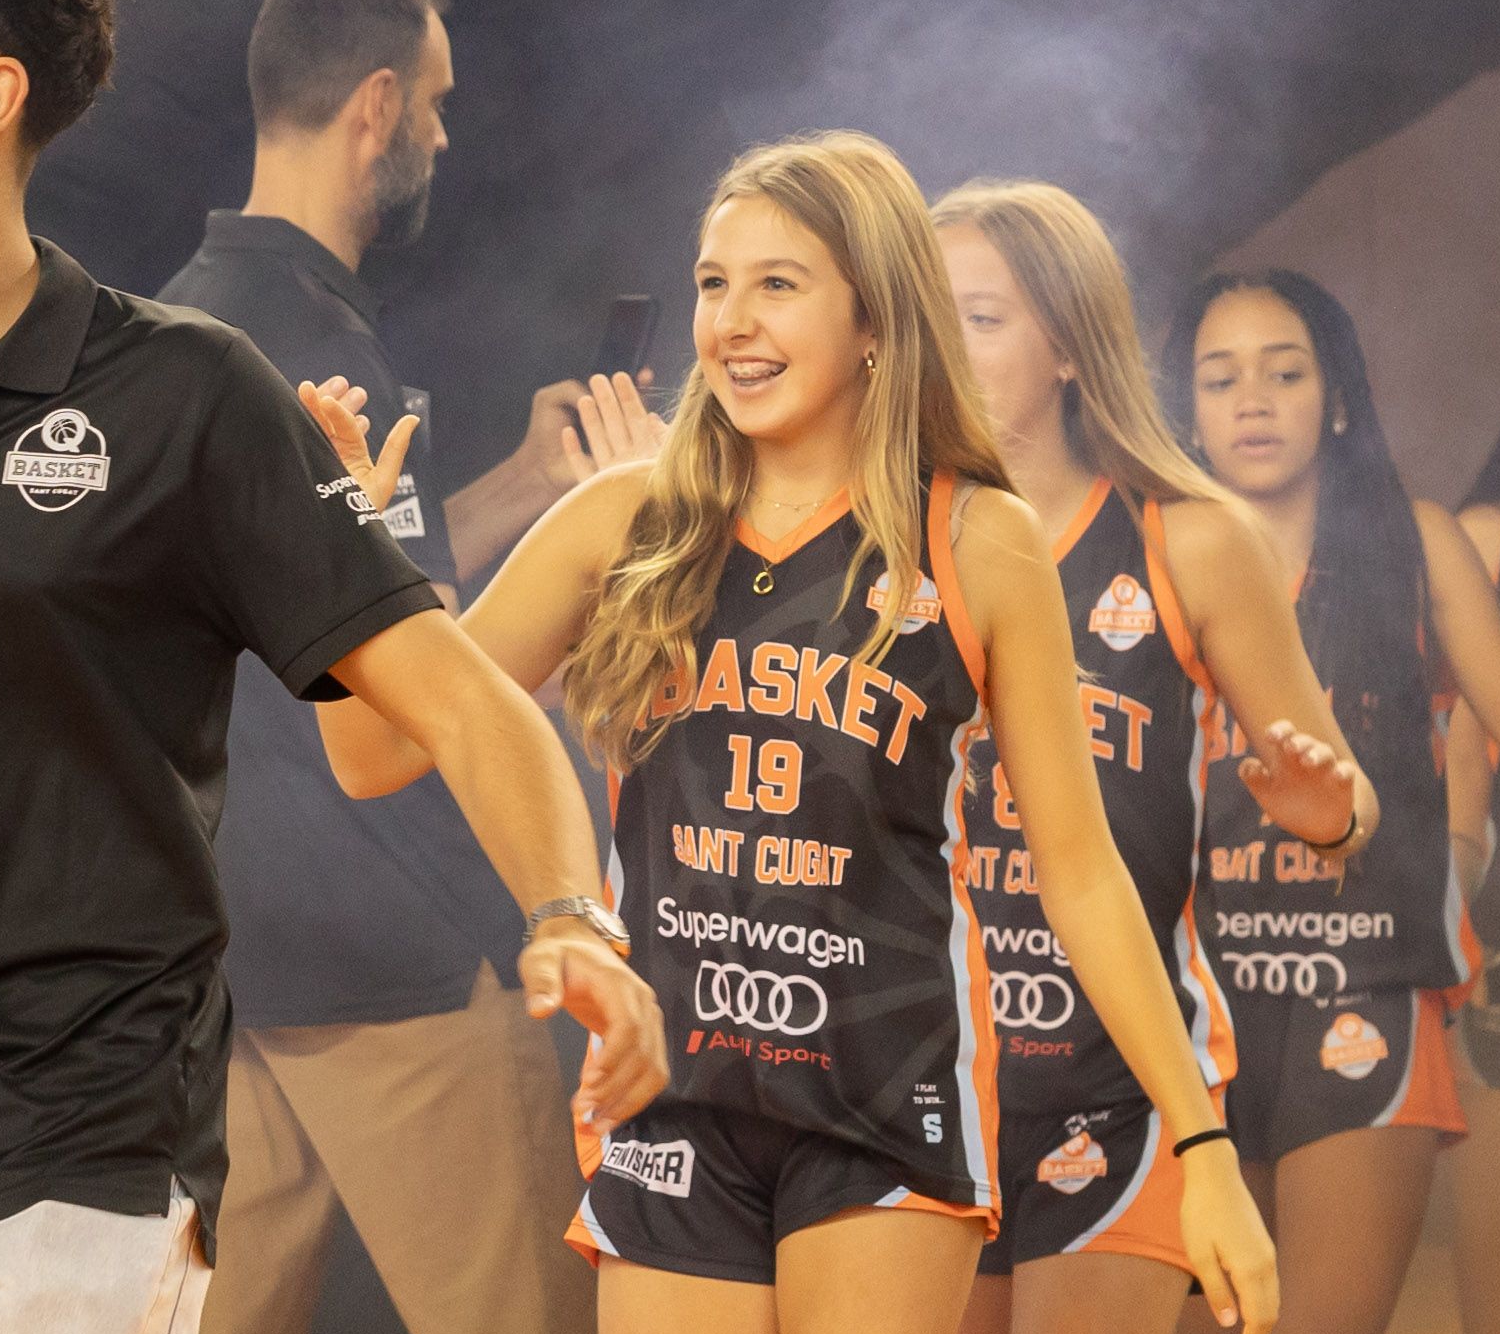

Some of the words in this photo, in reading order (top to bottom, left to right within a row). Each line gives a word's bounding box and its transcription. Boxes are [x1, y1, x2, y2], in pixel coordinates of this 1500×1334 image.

[12, 459, 101, 480] BASKET
[725, 734, 803, 814] 19
[672, 824, 745, 878] SANT
[754, 835, 853, 886] CUGAT
[656, 896, 866, 967] Superwagen
[758, 1040, 833, 1071] Sport
[1009, 1035, 1074, 1058] Sport
[606, 1146, 685, 1185] FINISHER
